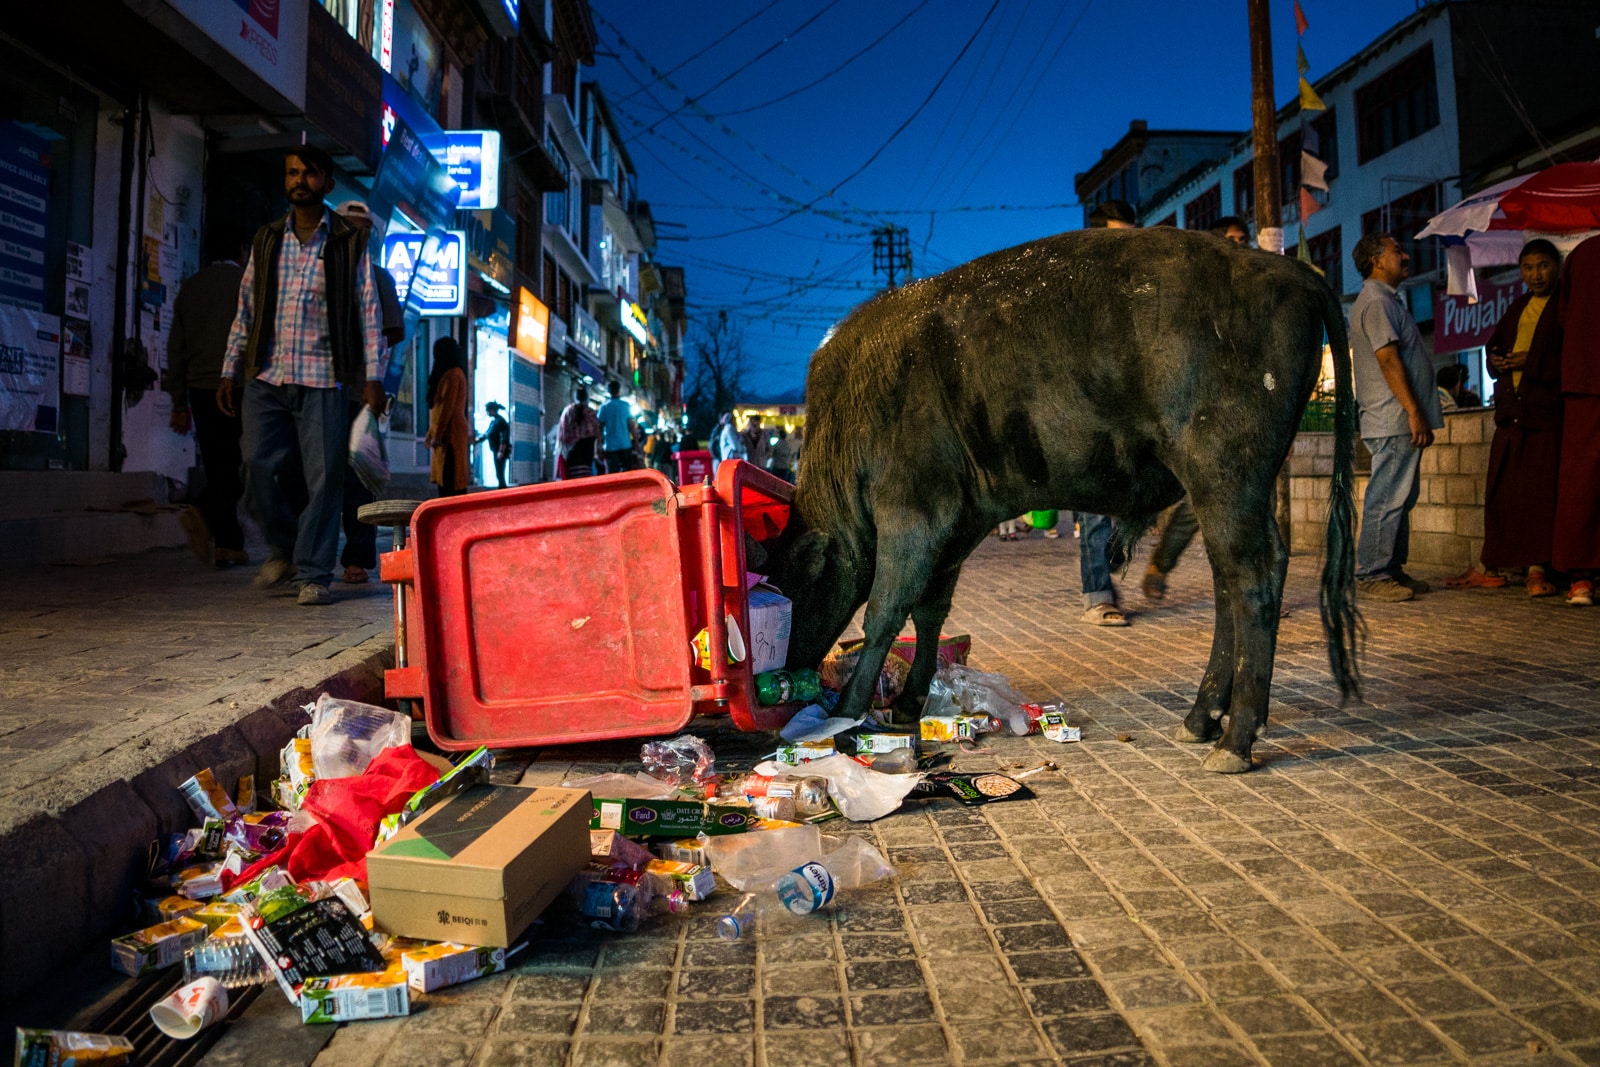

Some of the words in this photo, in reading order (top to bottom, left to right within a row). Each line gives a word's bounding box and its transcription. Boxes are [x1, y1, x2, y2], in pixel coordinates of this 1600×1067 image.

[387, 241, 459, 270] ATM
[1443, 285, 1515, 337] Punjabi
[635, 810, 651, 820] Fard
[807, 865, 828, 894] kinley
[452, 915, 474, 926] BEIQI
